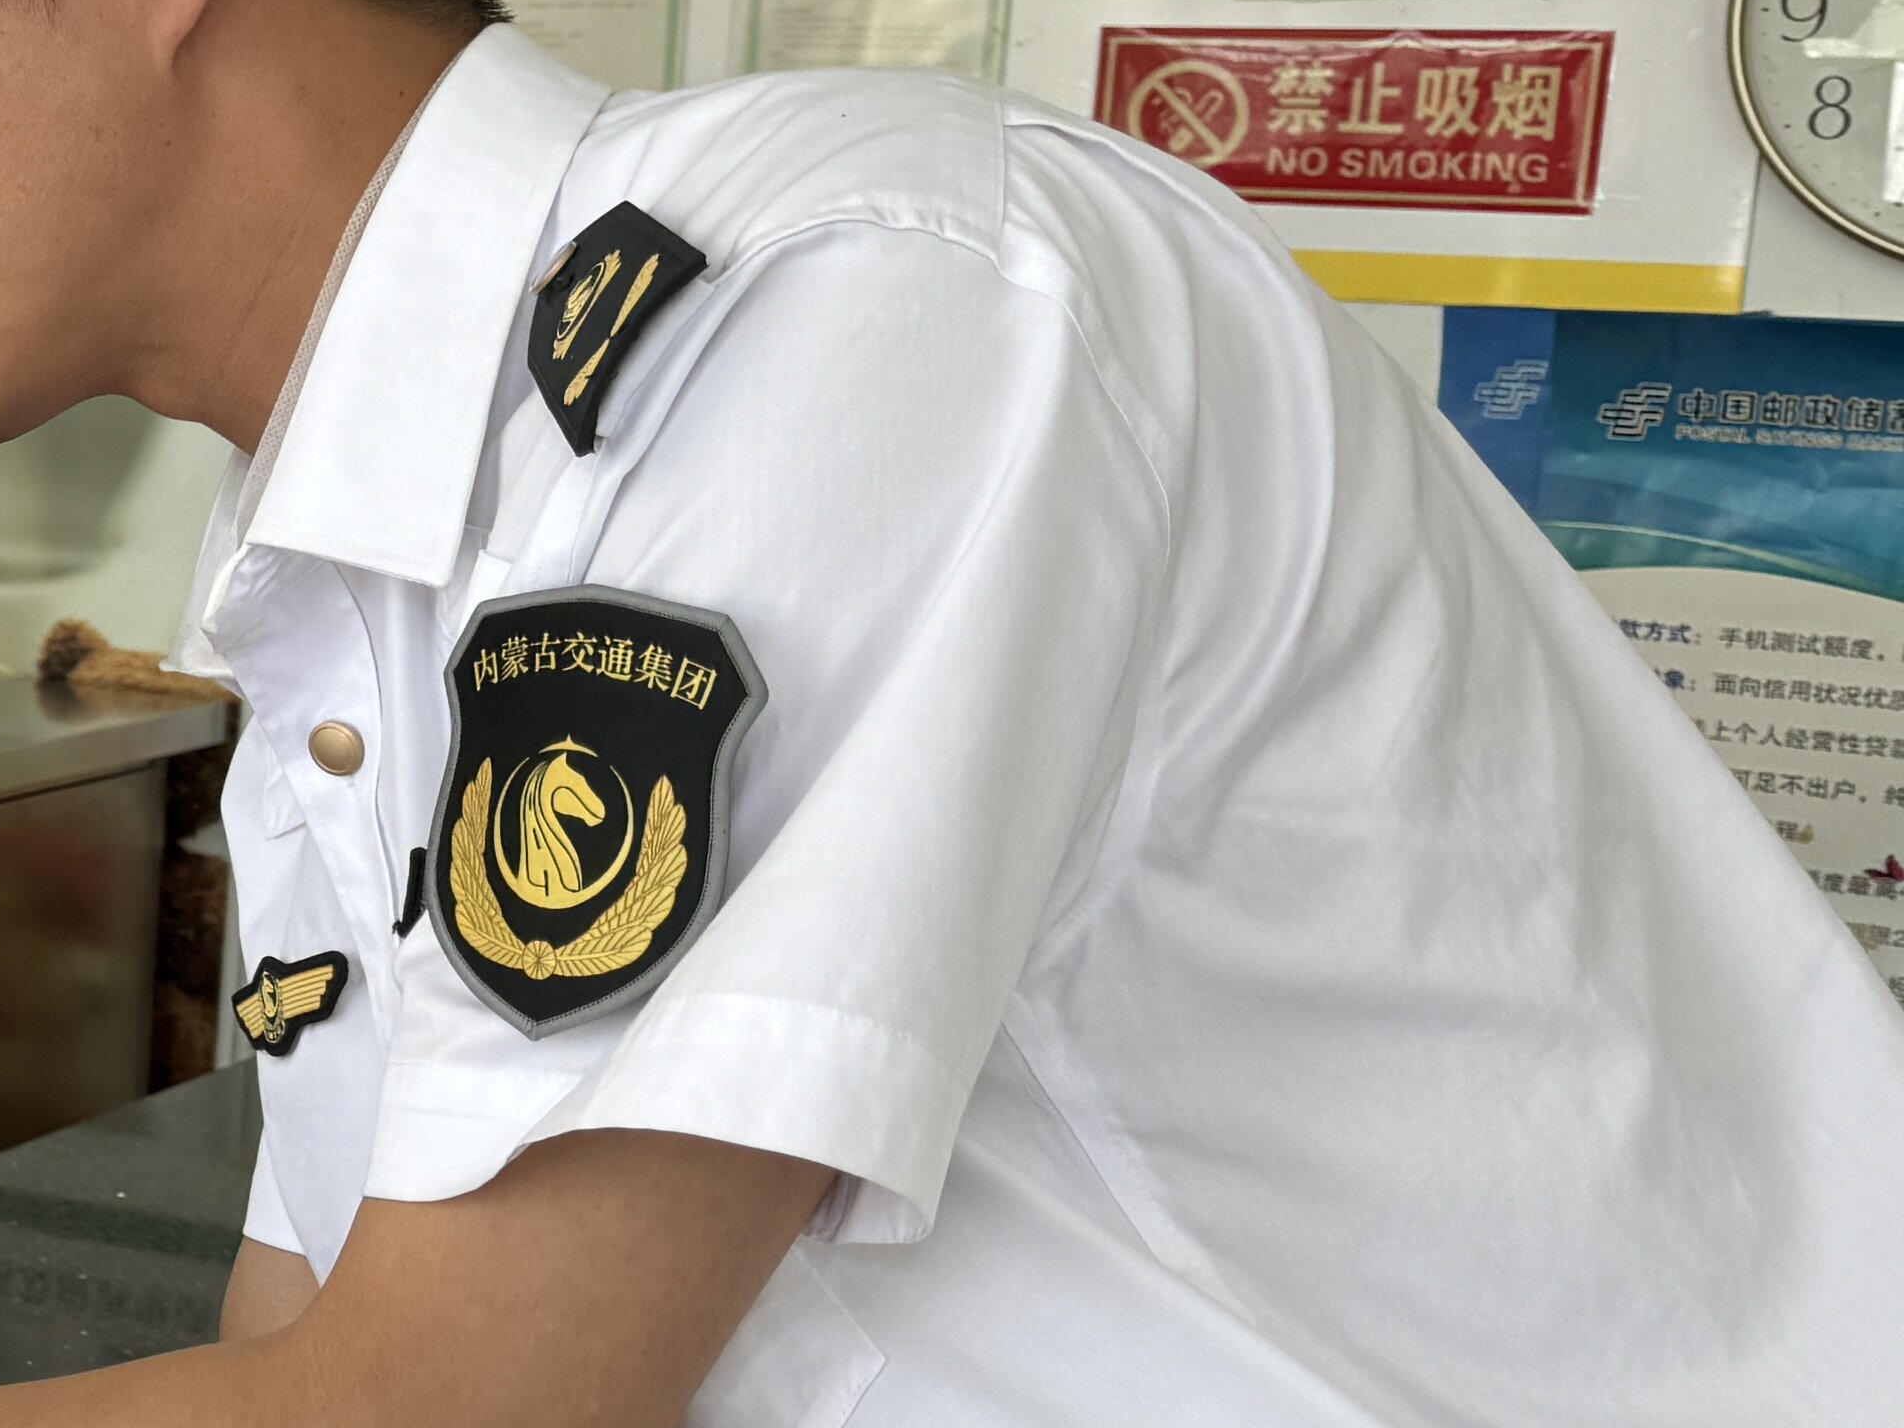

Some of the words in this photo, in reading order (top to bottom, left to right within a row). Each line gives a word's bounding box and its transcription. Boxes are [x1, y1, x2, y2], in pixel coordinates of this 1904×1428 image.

[1266, 55, 1565, 142] 禁止吸烟
[1808, 76, 1851, 140] 8
[1266, 146, 1328, 177] NO
[1340, 148, 1550, 185] SMOKING
[473, 630, 718, 710] 内蒙古交通集团
